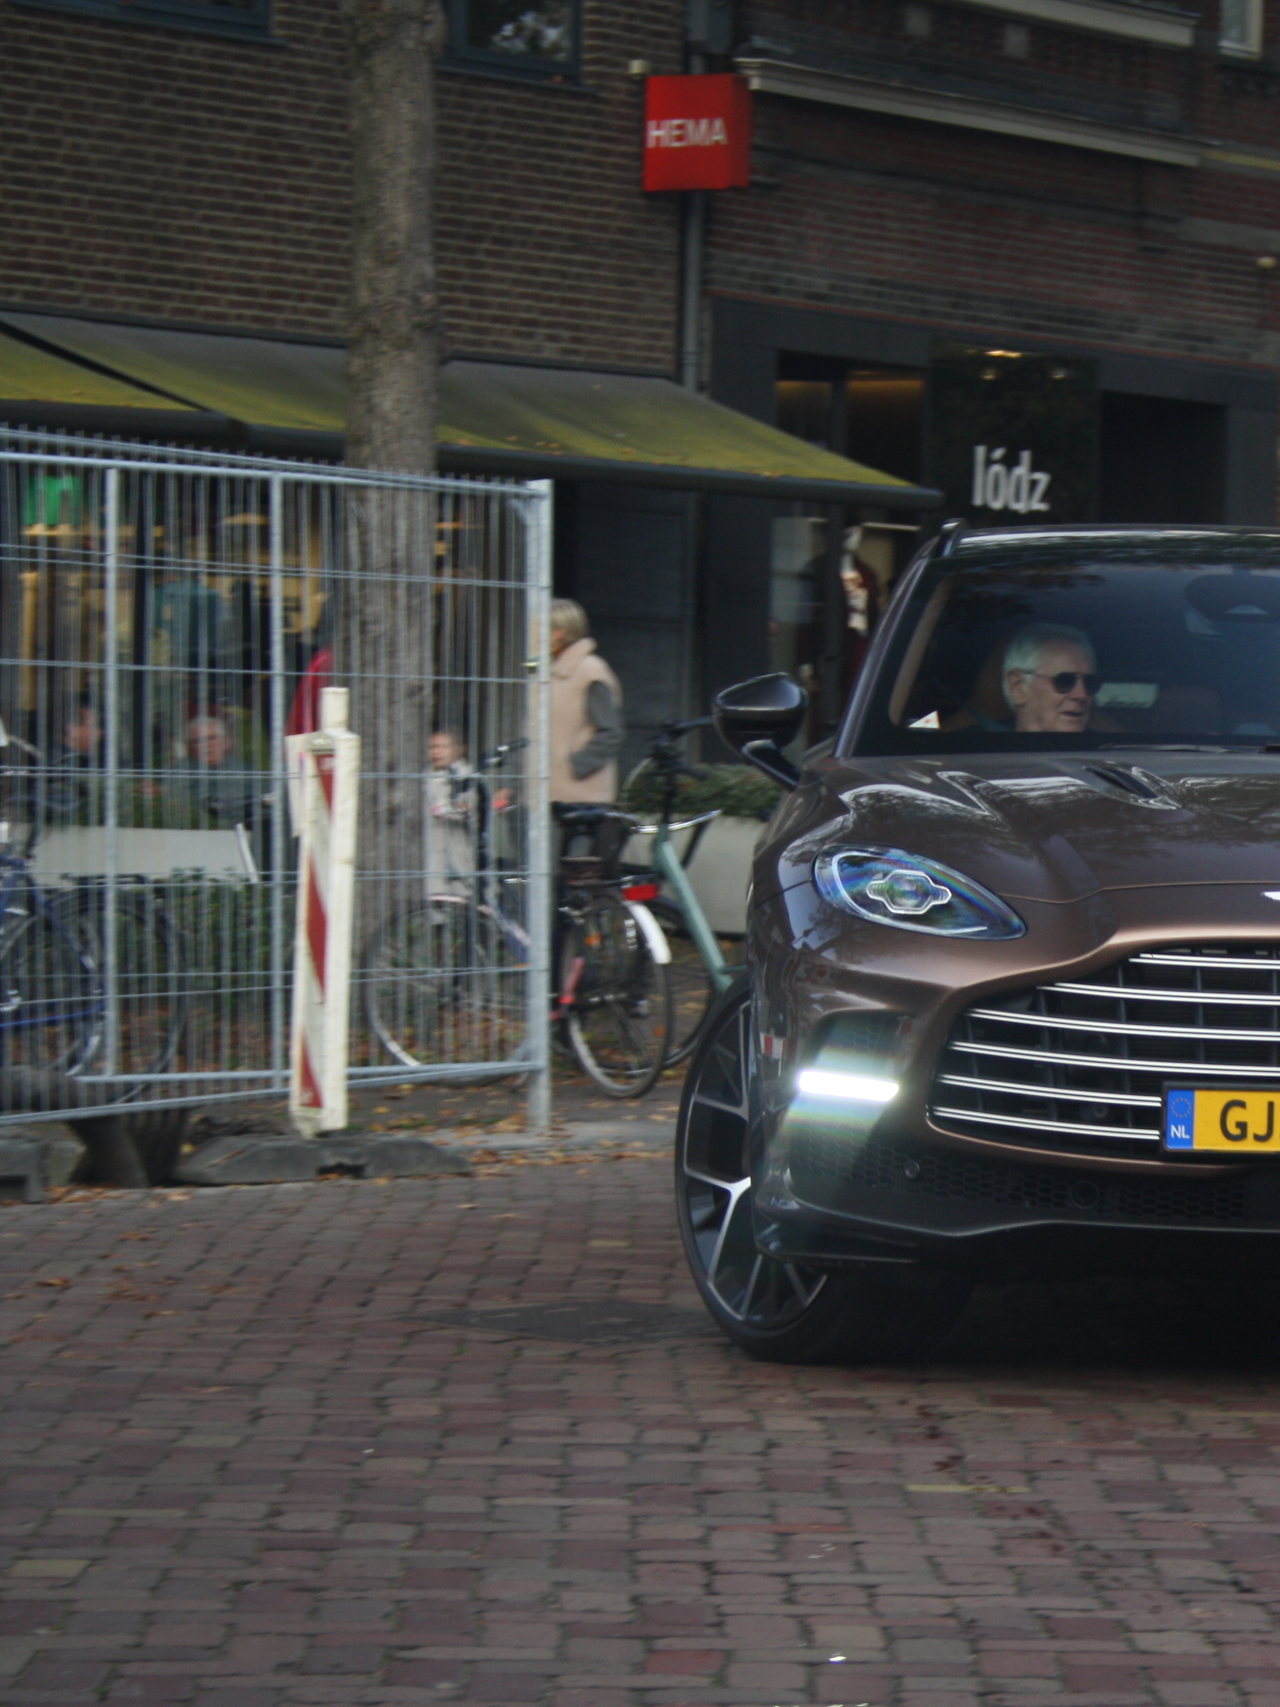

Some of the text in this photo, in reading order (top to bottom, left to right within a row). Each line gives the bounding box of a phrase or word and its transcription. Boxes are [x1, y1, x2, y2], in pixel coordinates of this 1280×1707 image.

[646, 118, 728, 148] HEMA
[972, 444, 1052, 513] lódz
[1170, 1125, 1190, 1139] NL
